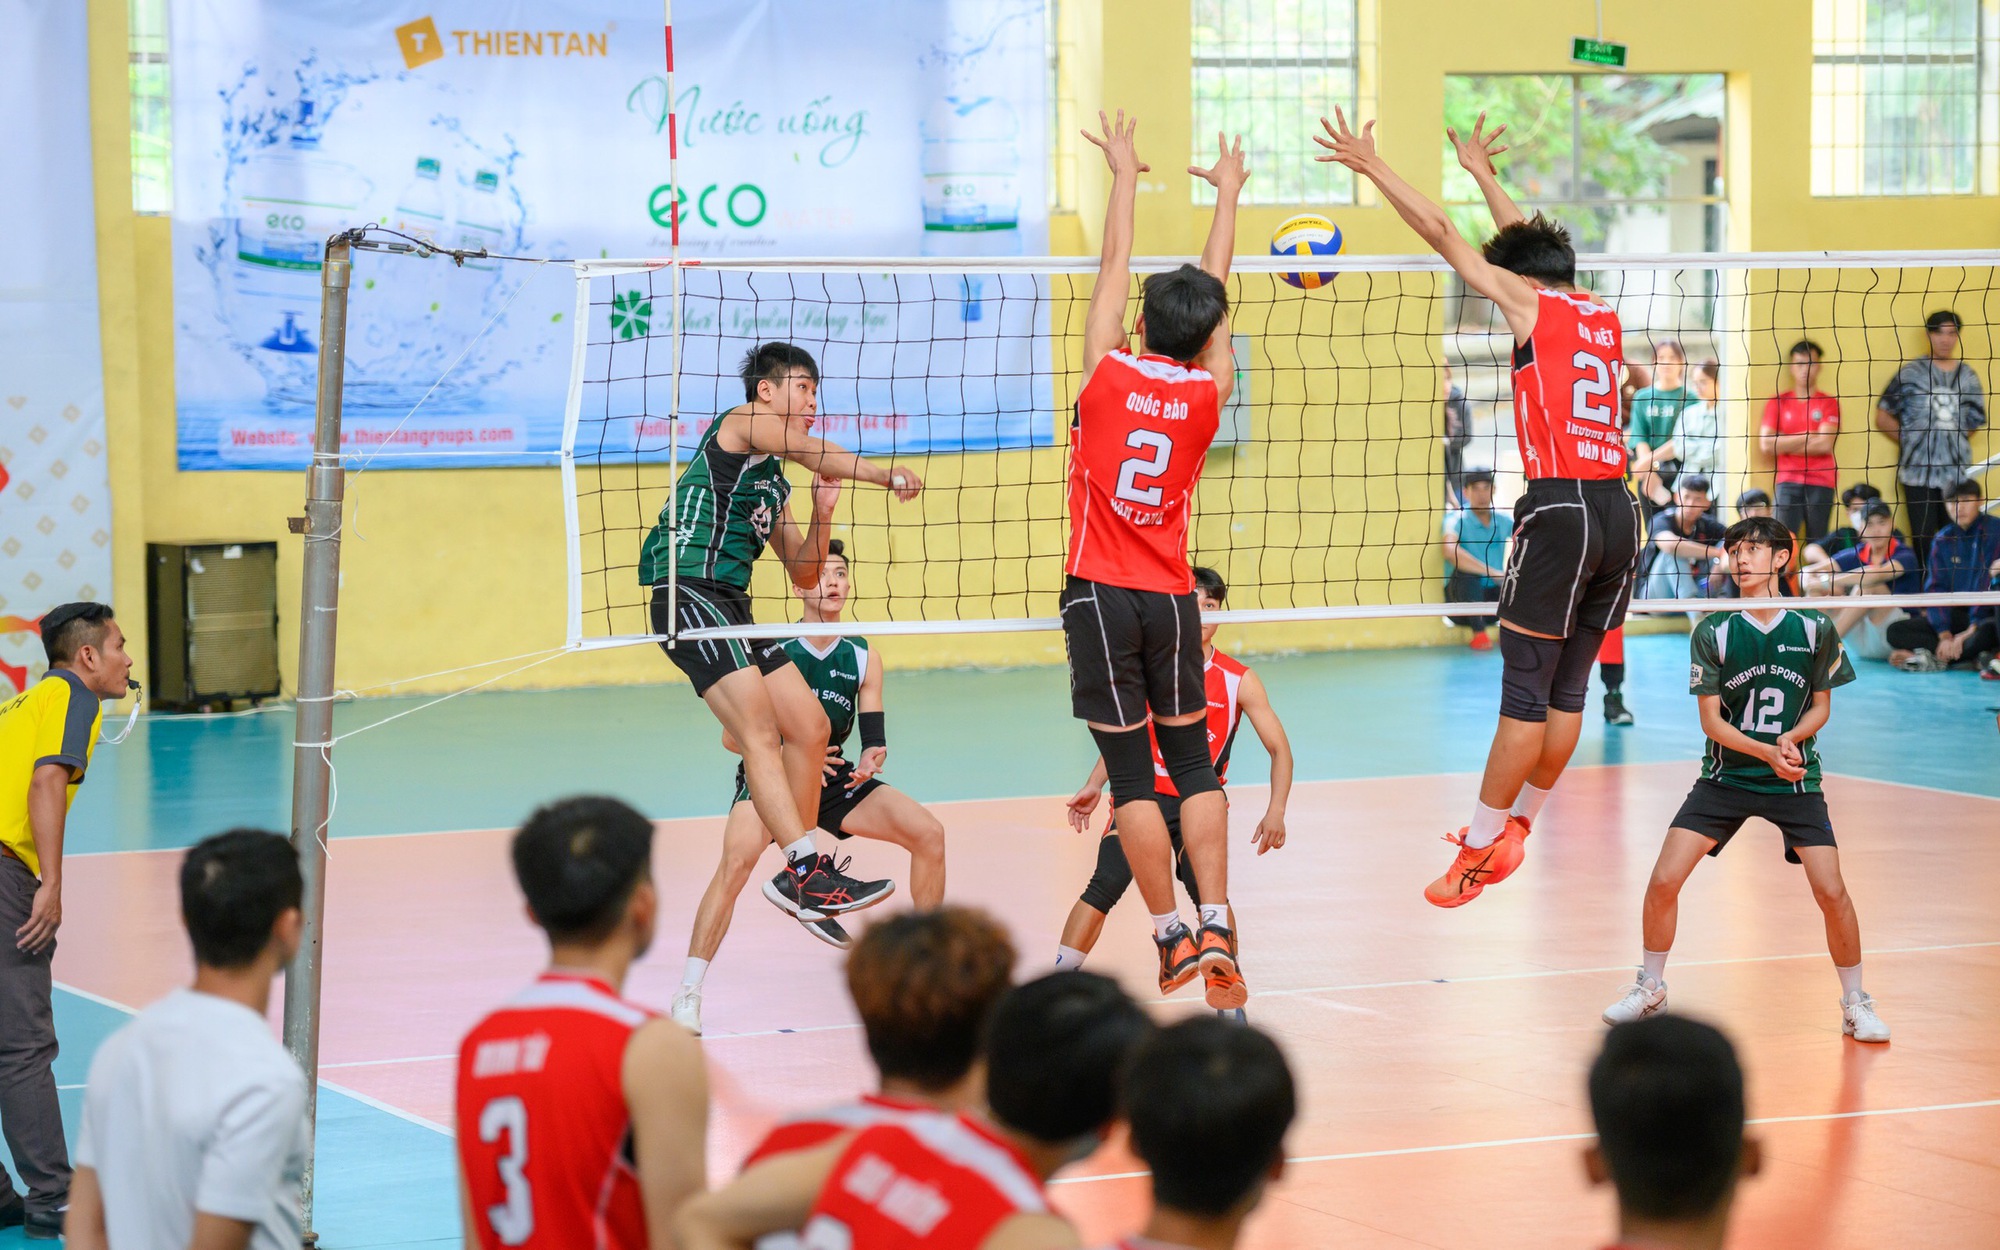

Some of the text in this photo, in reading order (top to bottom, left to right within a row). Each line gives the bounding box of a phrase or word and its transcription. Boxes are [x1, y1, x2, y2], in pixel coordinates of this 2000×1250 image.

[452, 31, 607, 57] THIENTAN
[1126, 392, 1188, 420] QUỐC BẢO
[1577, 440, 1600, 461] VĂN
[1115, 428, 1174, 507] 2
[1770, 664, 1806, 689] SPORTS
[1740, 687, 1785, 734] 12
[478, 1095, 534, 1246] 3
